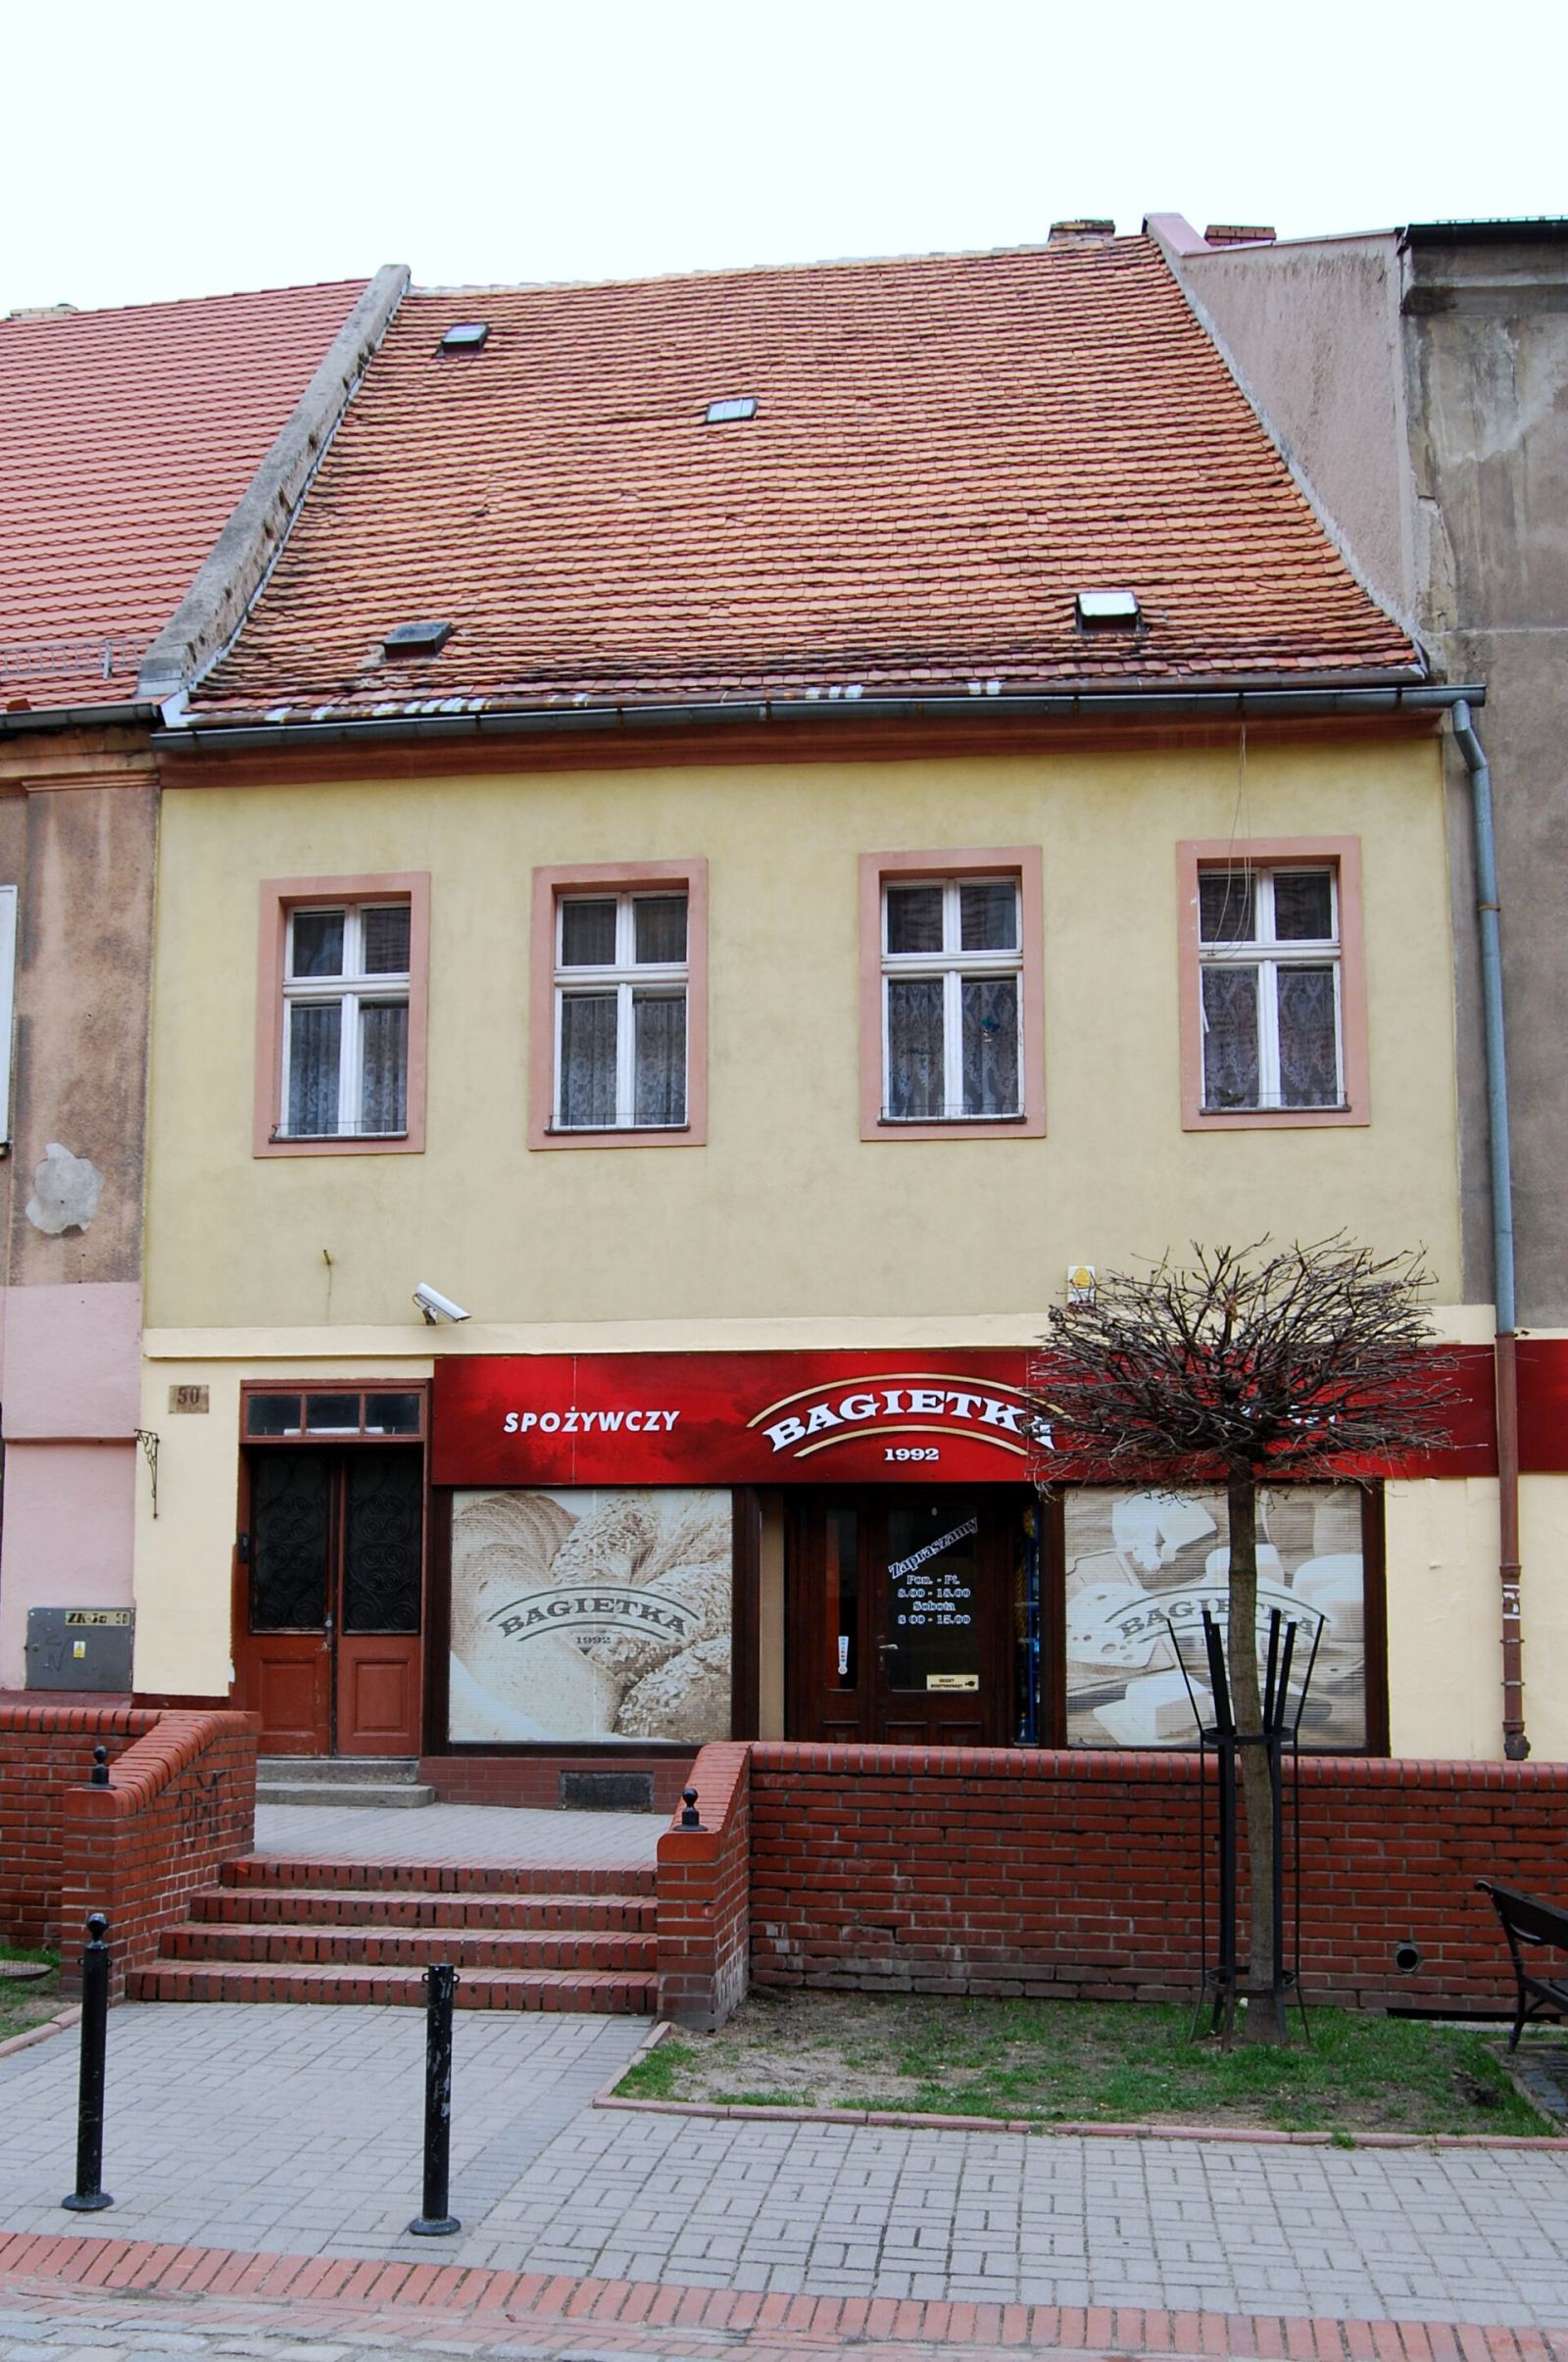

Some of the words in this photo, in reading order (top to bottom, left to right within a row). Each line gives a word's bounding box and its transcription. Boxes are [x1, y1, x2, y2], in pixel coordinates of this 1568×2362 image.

[177, 1386, 200, 1404] 50
[503, 1405, 680, 1433] SPOŻYWCZY
[761, 1389, 1055, 1452] BAGIETKA
[884, 1448, 940, 1461] 1992
[888, 1516, 979, 1579] Zapraszamy
[898, 1588, 926, 1599] 8.00
[937, 1588, 971, 1599] 18.00
[912, 1599, 956, 1611] Sobota
[498, 1598, 687, 1638] BAGIETKA
